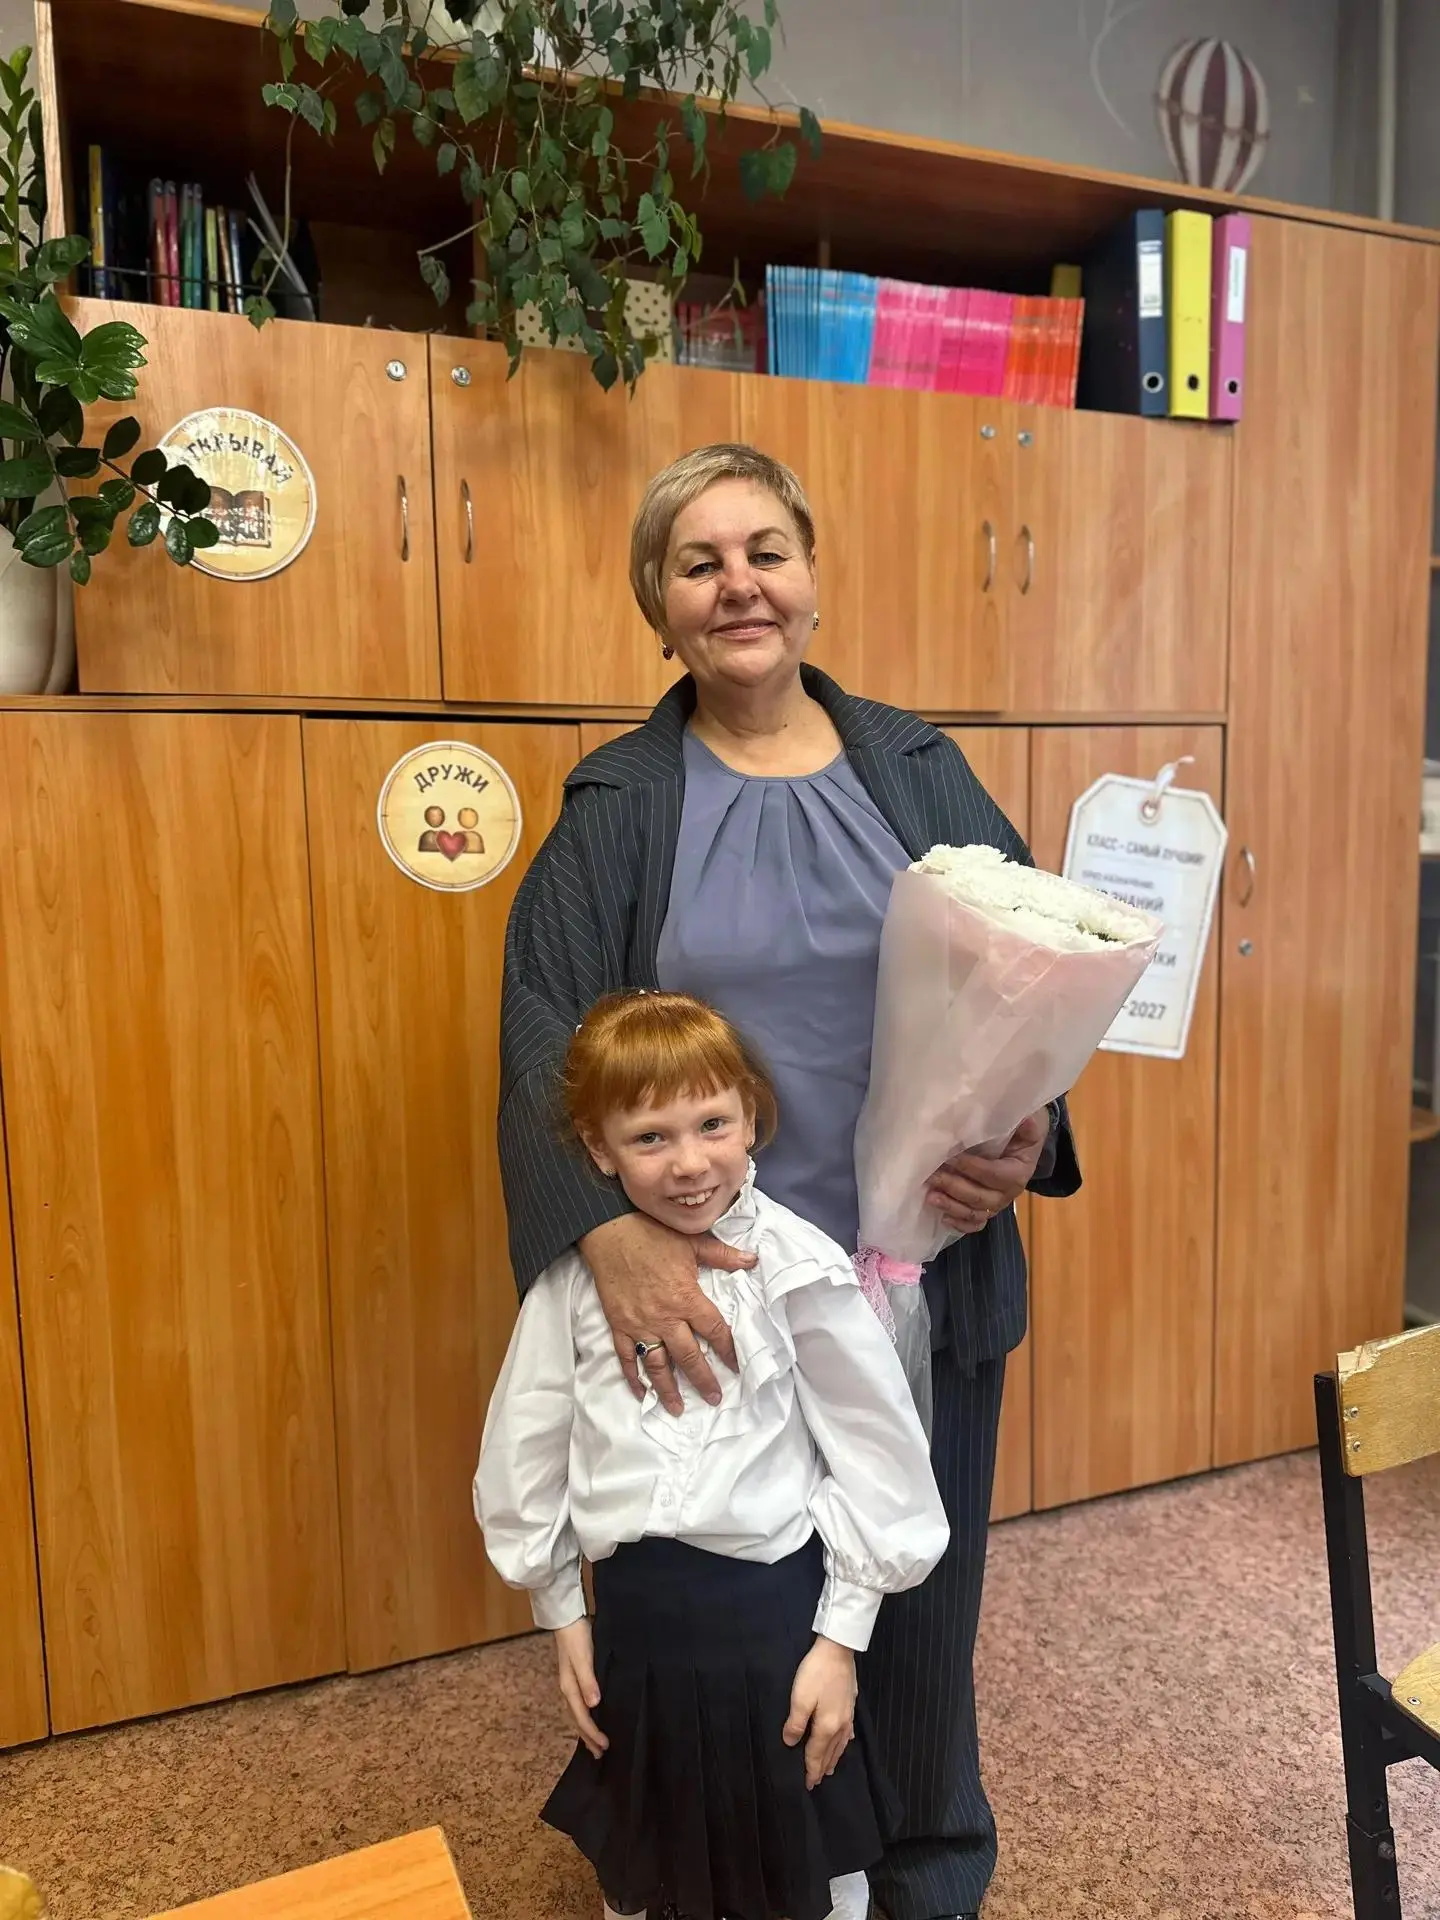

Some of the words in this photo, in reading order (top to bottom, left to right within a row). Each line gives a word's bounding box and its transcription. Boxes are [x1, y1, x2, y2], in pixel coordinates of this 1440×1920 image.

[178, 433, 294, 483] ТКРЫВАЙ
[413, 764, 489, 793] ДРУЖИ
[1087, 834, 1118, 851] КЛАСС
[1126, 841, 1161, 857] САМЫЙ
